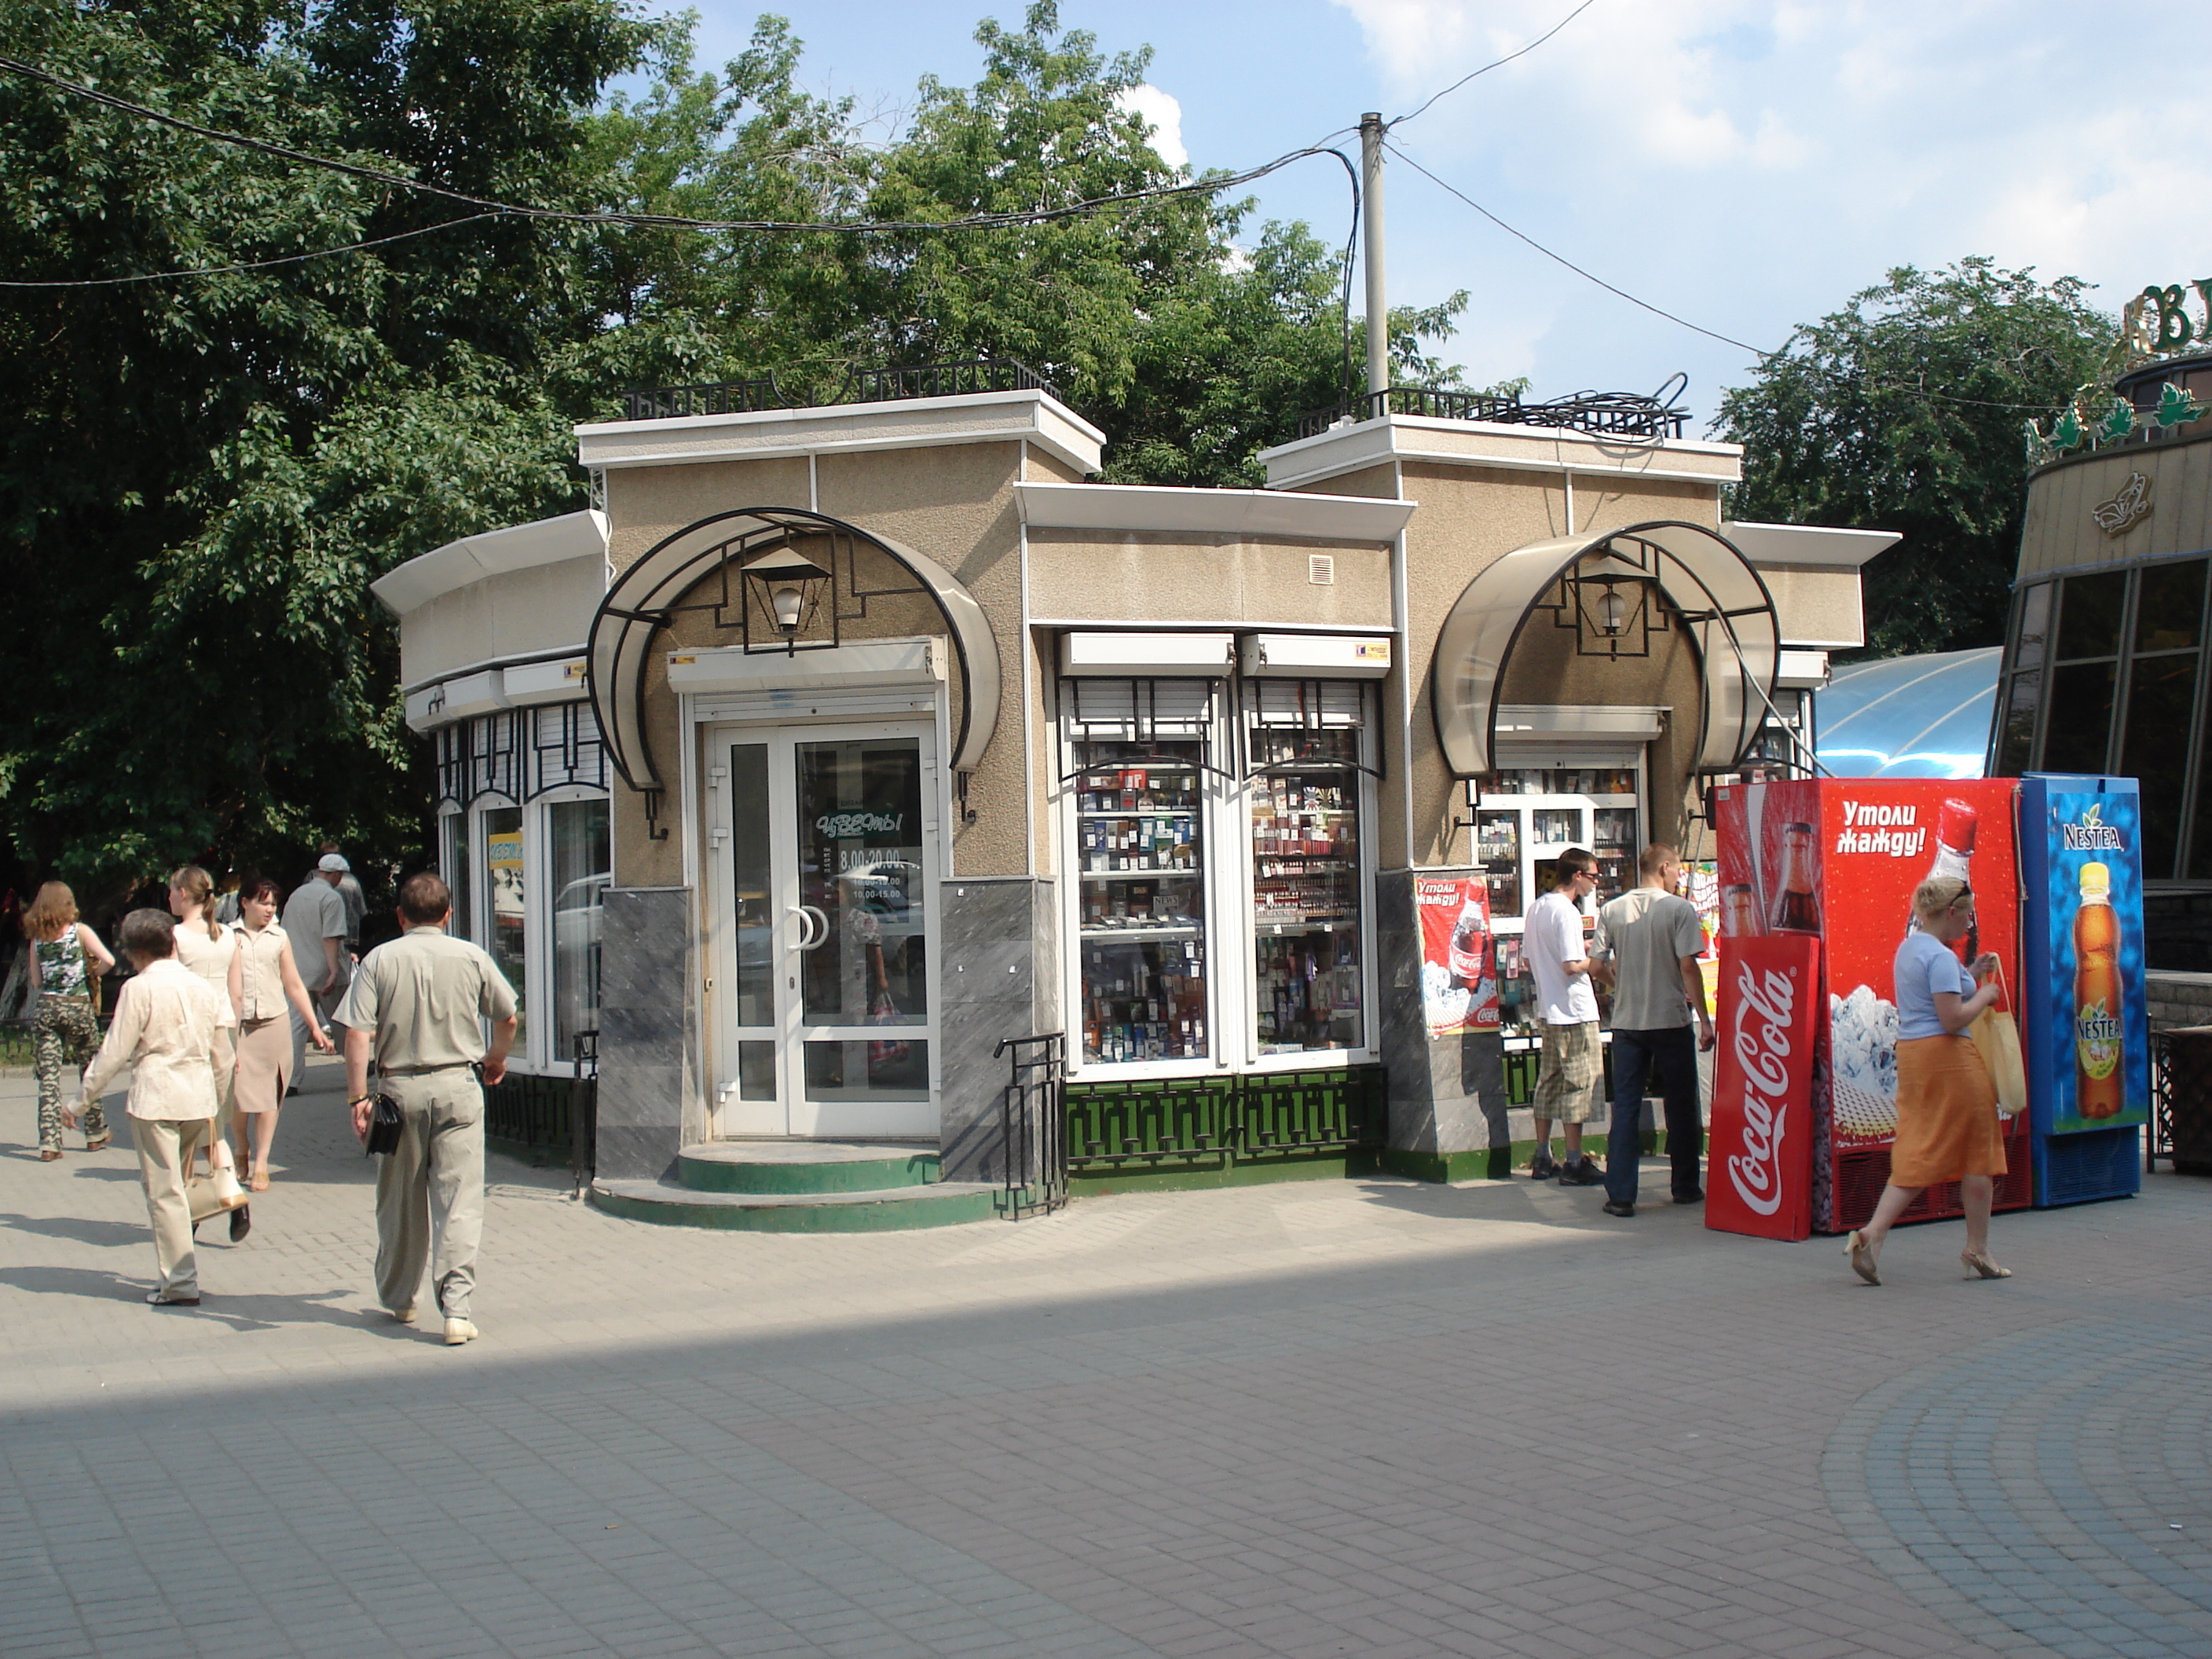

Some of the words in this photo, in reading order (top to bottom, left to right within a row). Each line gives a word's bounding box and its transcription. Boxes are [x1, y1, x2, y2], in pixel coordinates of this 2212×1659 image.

[1842, 800, 1917, 826] Утоли
[1837, 827, 1927, 858] жажду!
[2063, 823, 2124, 851] NESTEA
[1416, 892, 1459, 906] жажду!
[1418, 881, 1456, 893] Утоли
[1692, 884, 1719, 902] БОКА
[2076, 1016, 2122, 1039] NESTEA
[1728, 959, 1794, 1216] Coca-Cola
